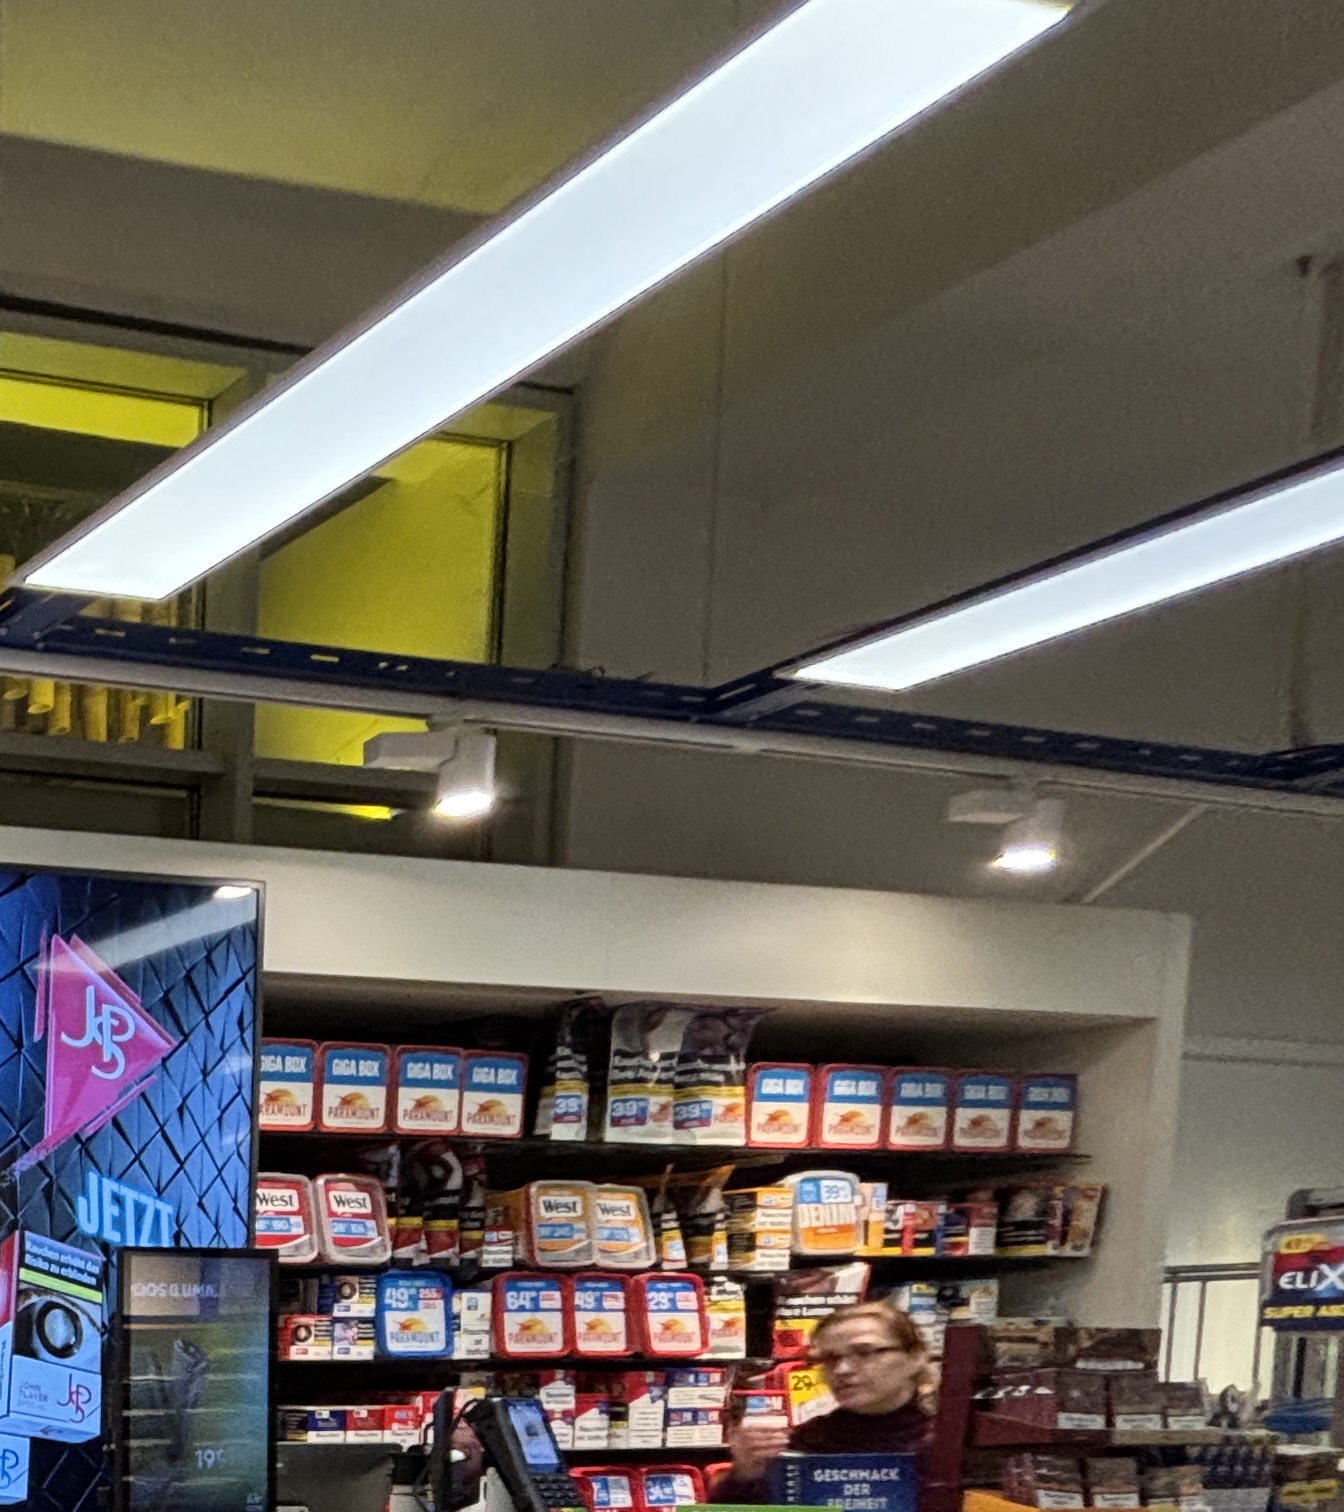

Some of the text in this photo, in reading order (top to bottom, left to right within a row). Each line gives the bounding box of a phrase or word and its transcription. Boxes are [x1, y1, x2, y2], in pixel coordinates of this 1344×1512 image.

[284, 1055, 307, 1074] BOX
[331, 1058, 381, 1078] GIGA BOX
[406, 1062, 454, 1081] GIGA BOX
[471, 1066, 518, 1085] GIGA BOX
[77, 1170, 174, 1247] JETZT
[332, 1193, 370, 1212] West
[542, 1198, 579, 1216] West
[595, 1201, 633, 1219] West
[796, 1204, 858, 1229] DENIM
[812, 1467, 901, 1482] GESCHMACK
[842, 1483, 872, 1498] DER
